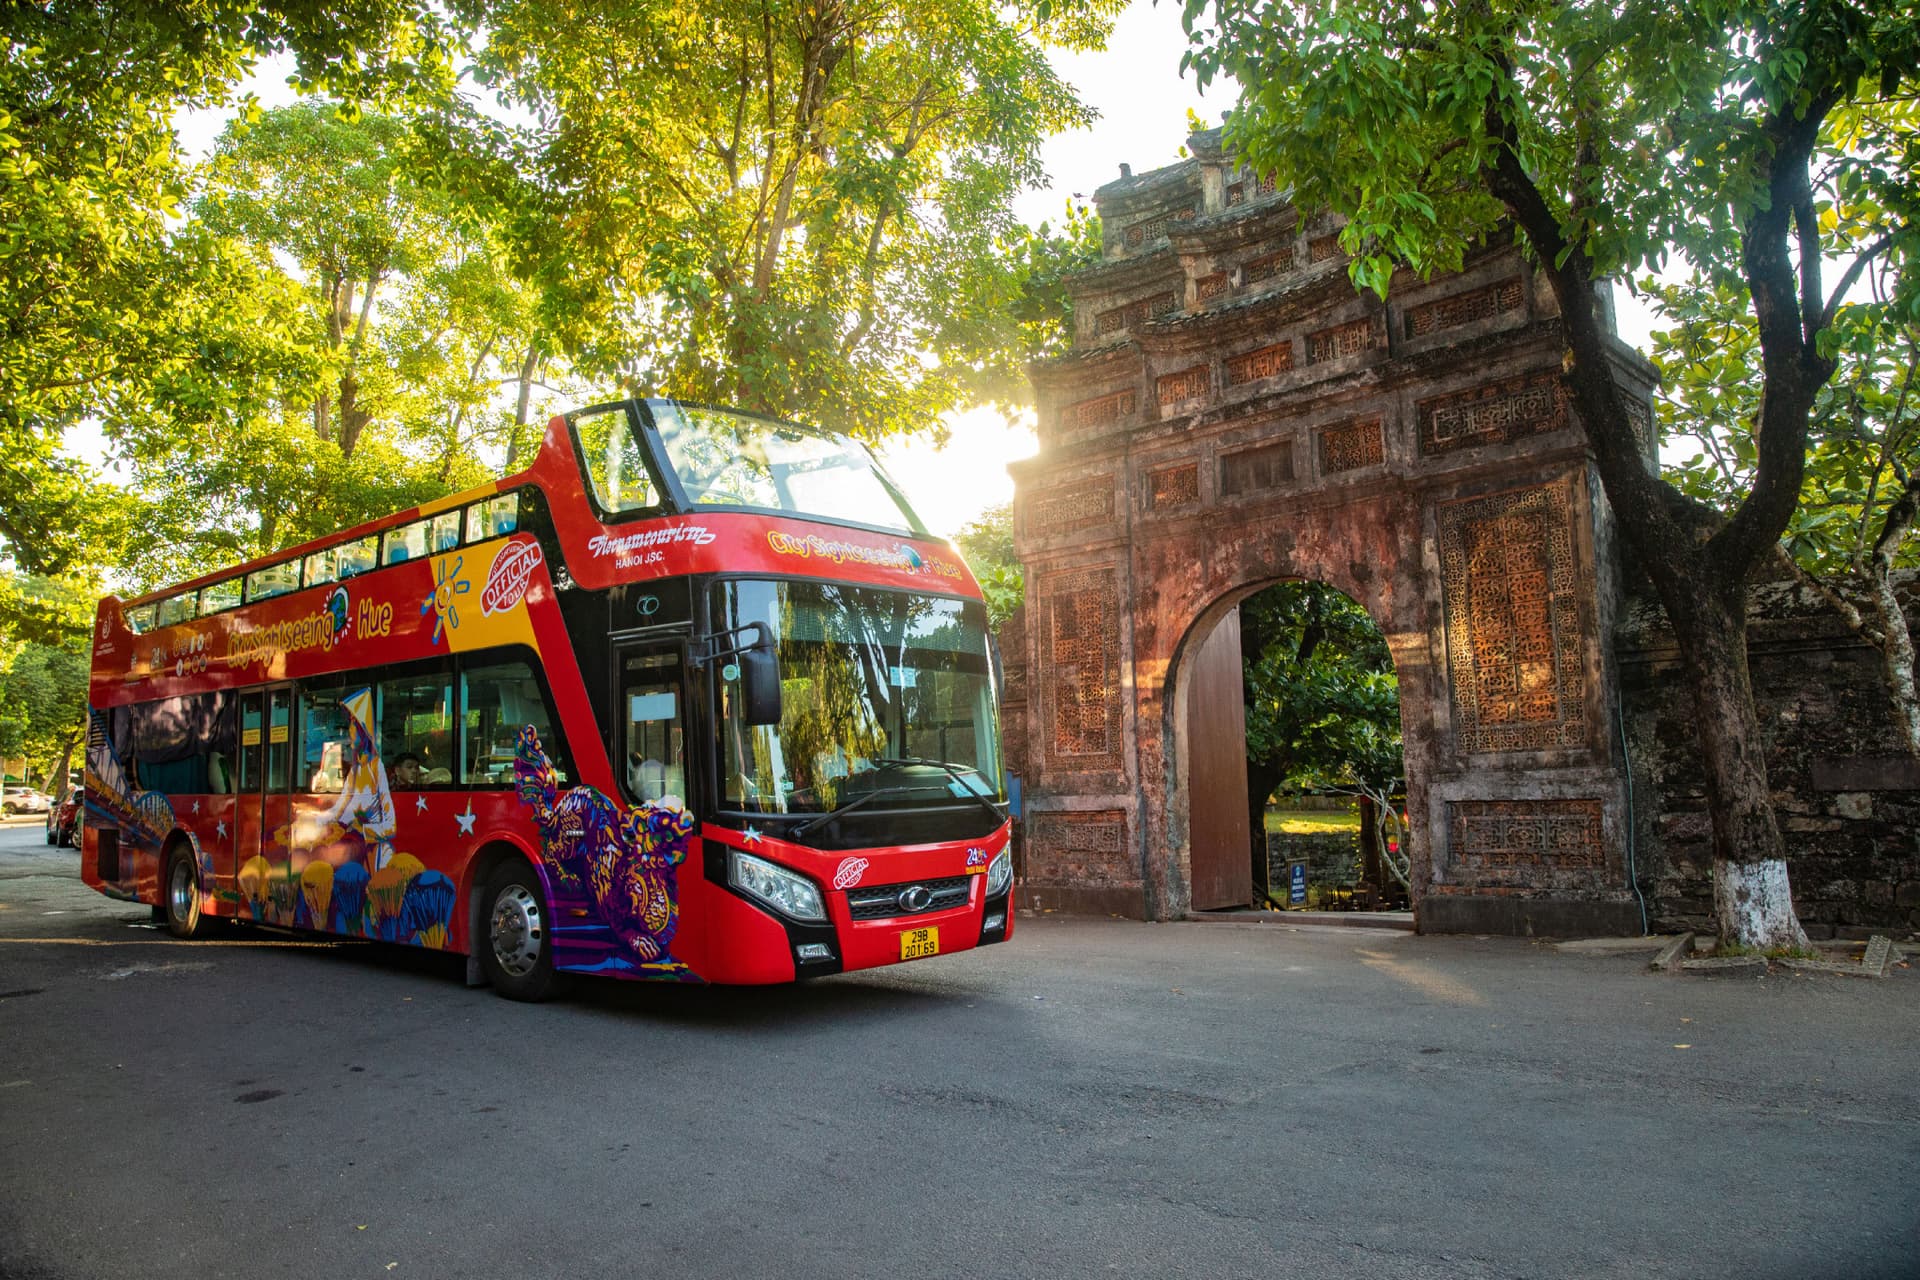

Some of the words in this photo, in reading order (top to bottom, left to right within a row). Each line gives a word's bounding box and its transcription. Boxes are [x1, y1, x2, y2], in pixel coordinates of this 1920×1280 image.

[588, 522, 717, 558] Vietnamtourism
[615, 554, 643, 570] HANOI
[486, 548, 538, 606] OFFICIAL
[502, 578, 527, 607] TOUR
[357, 597, 393, 640] Hue
[837, 859, 867, 885] OFFICIAL
[911, 929, 929, 944] 29B
